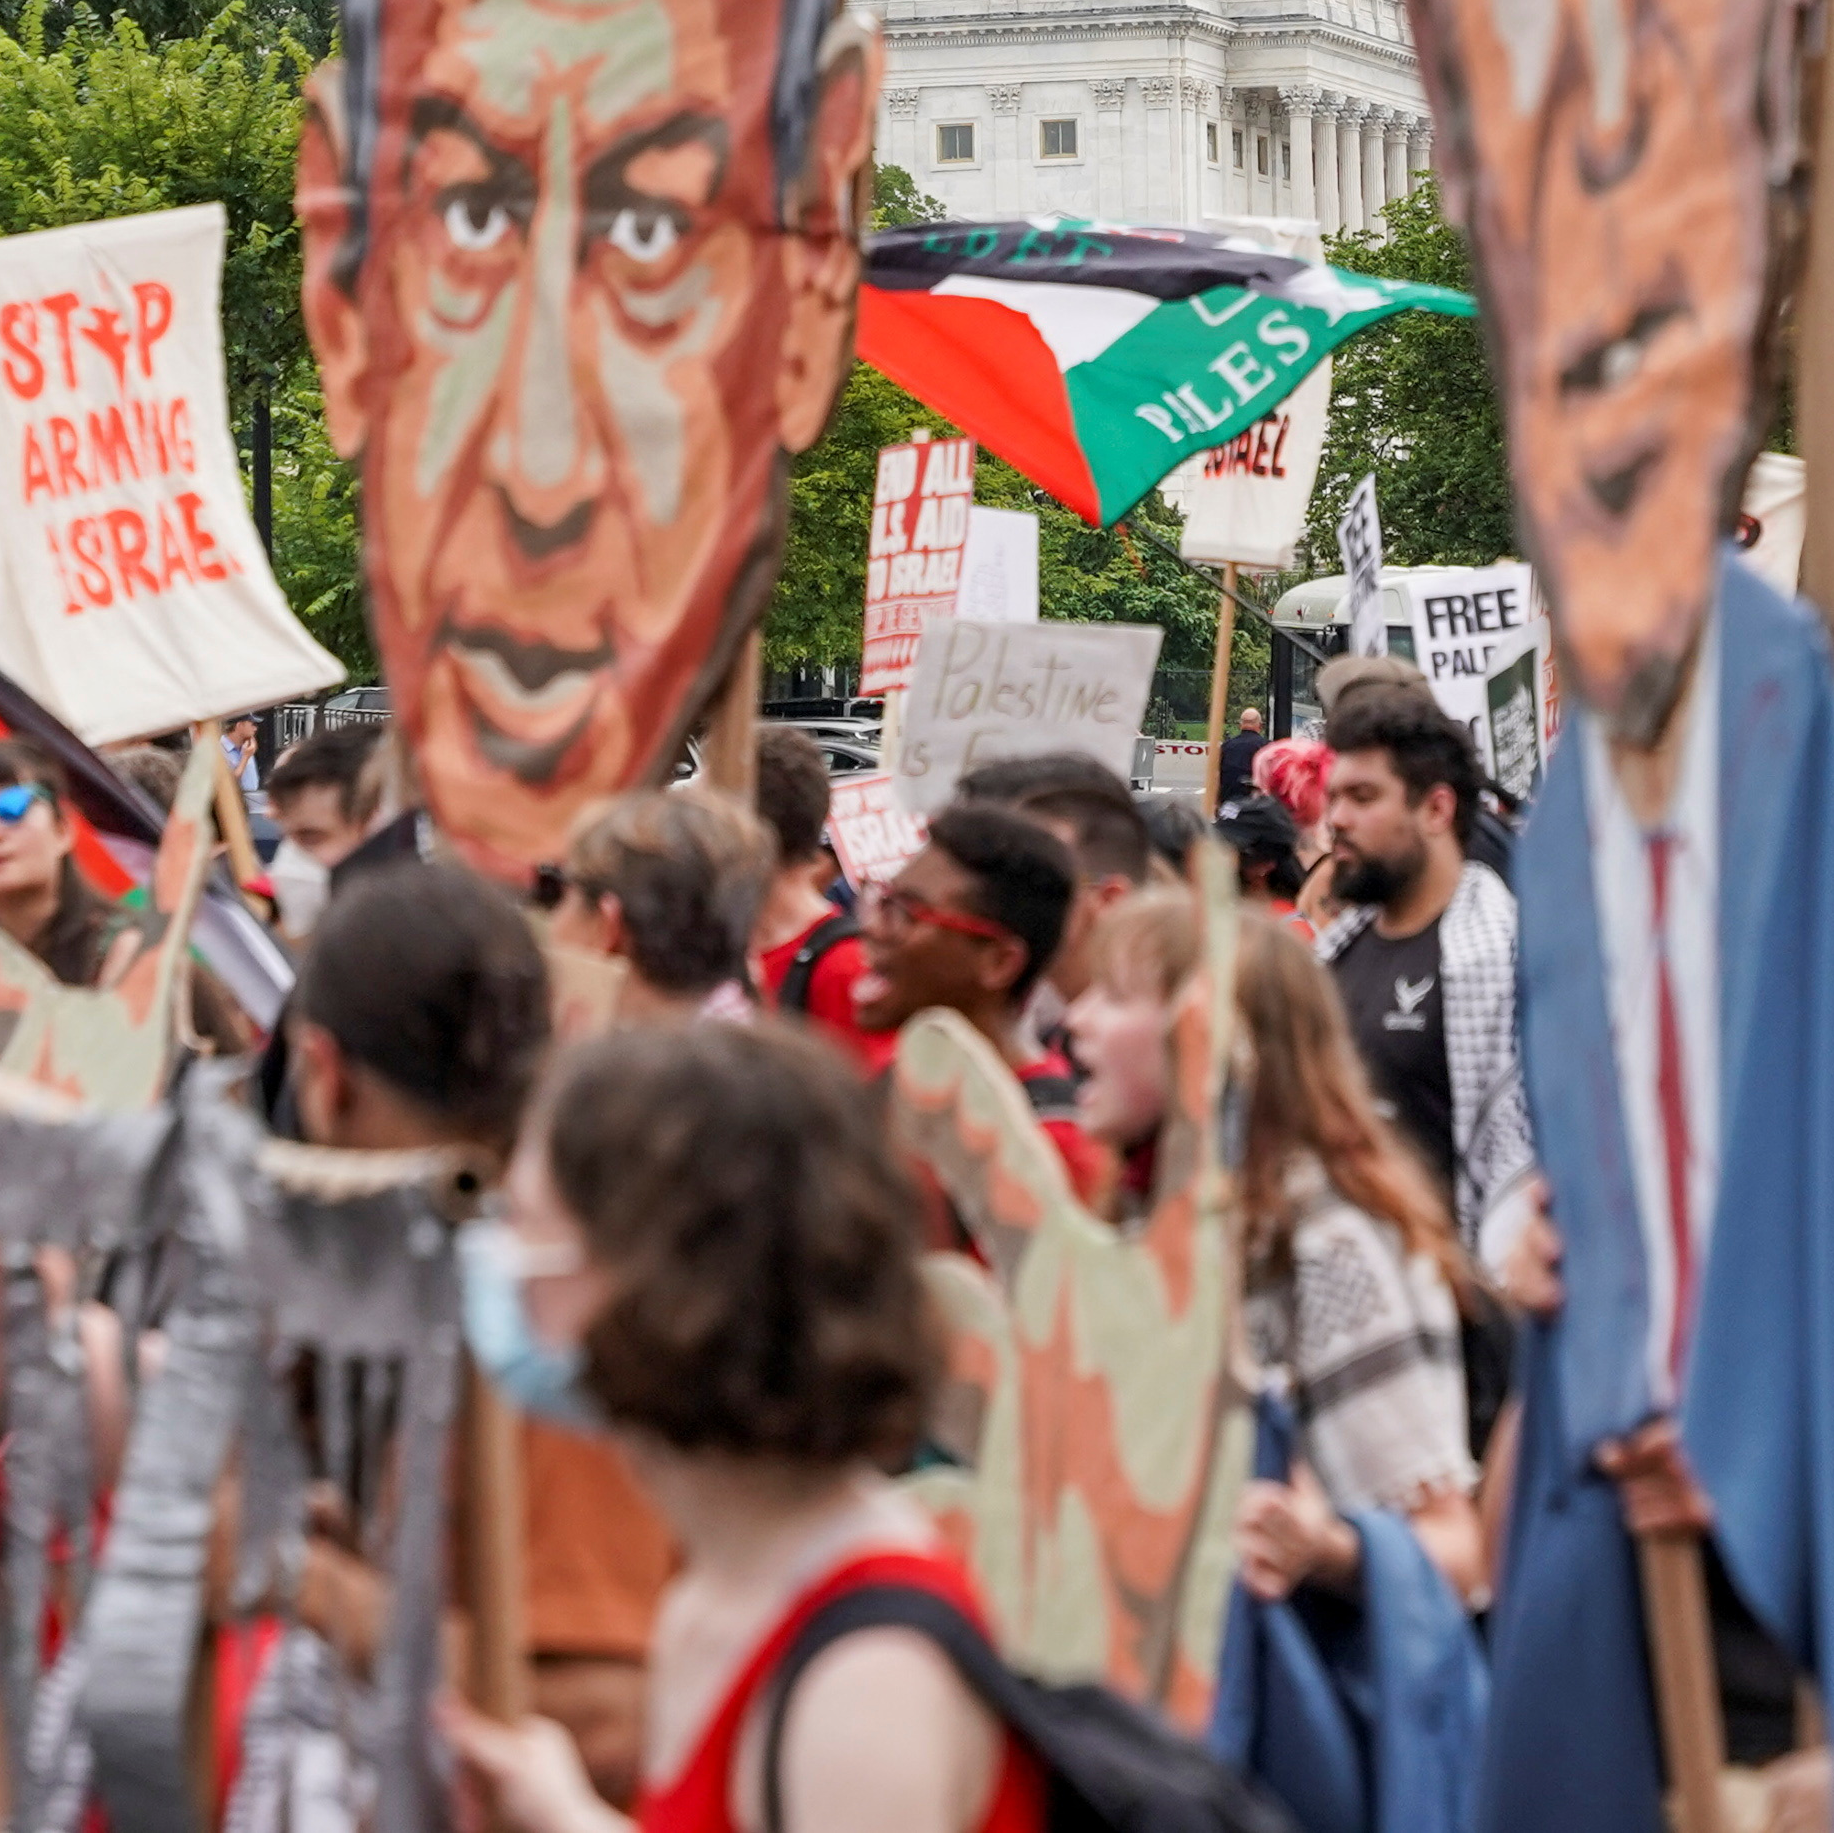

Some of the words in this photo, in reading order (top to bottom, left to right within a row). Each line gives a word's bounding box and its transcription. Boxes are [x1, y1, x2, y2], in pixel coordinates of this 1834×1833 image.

[921, 441, 973, 500] ALL
[912, 493, 969, 553] AID
[45, 491, 245, 617] ISRAE
[1423, 587, 1523, 640] FREE
[1154, 745, 1209, 756] STO
